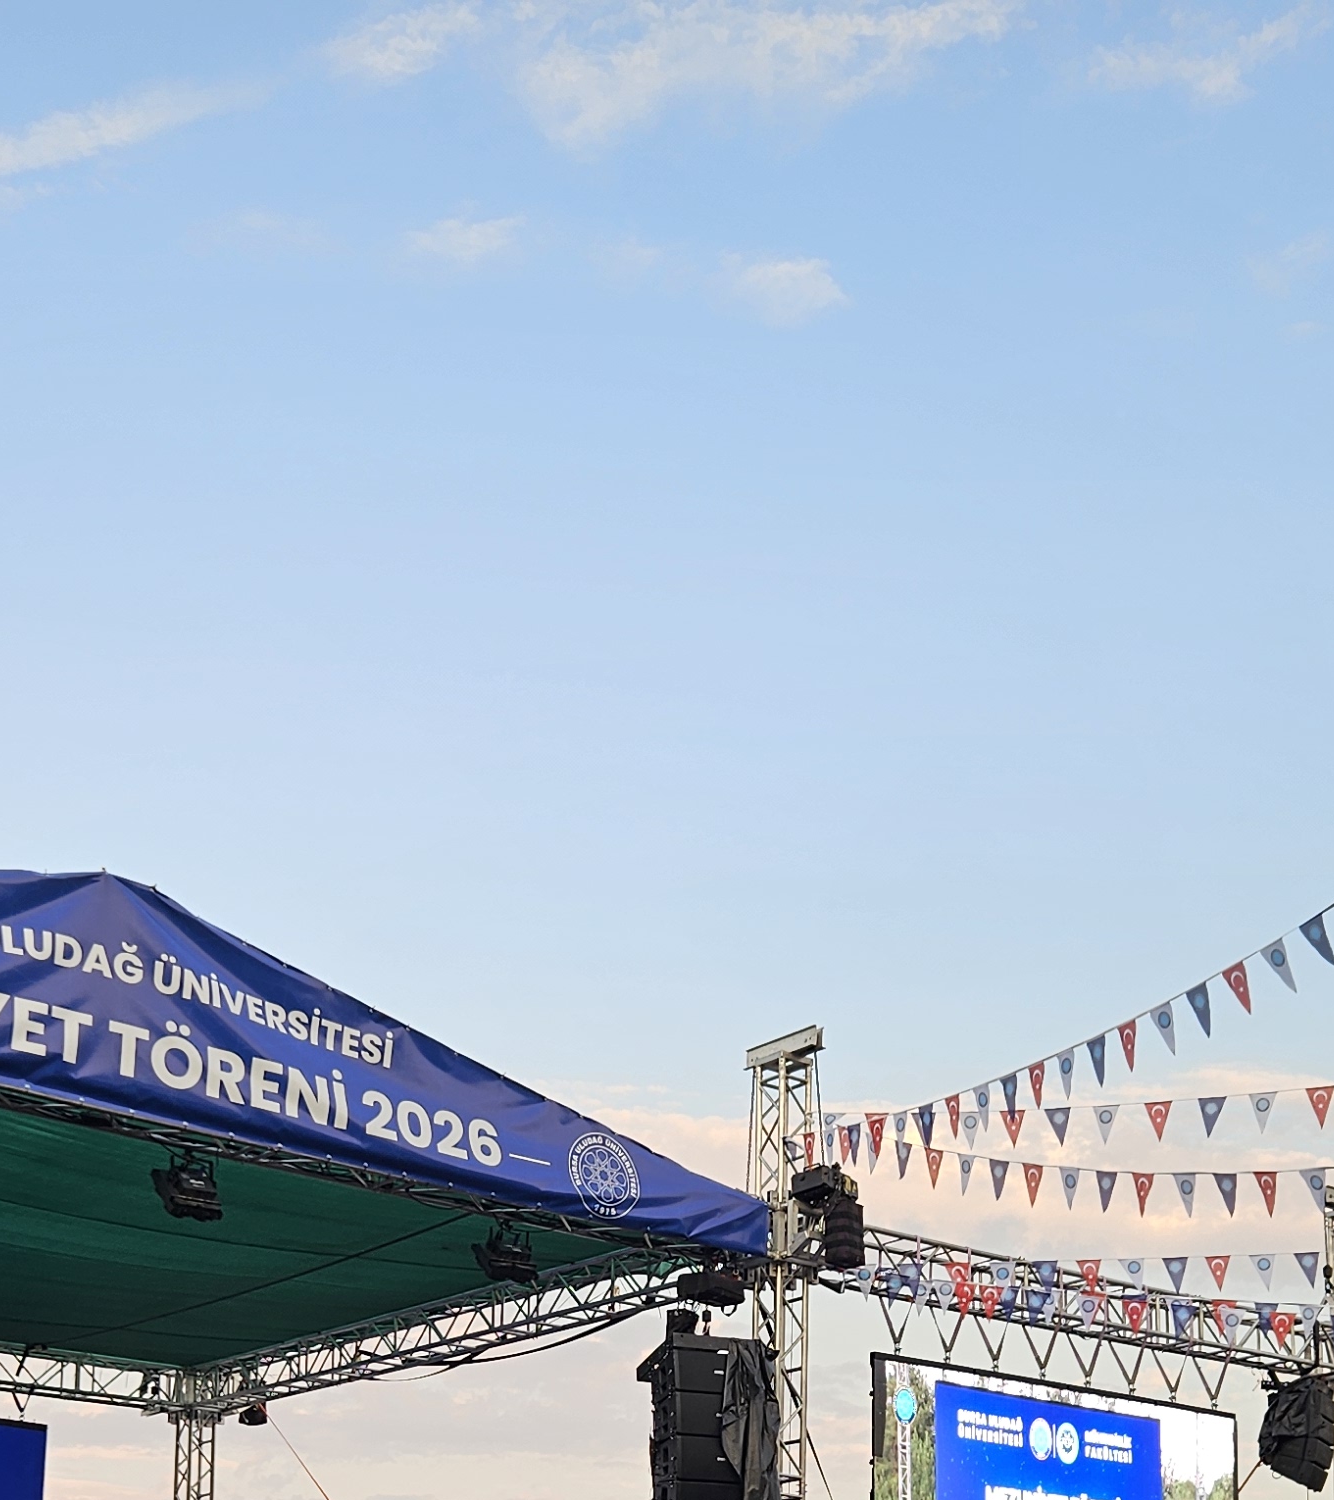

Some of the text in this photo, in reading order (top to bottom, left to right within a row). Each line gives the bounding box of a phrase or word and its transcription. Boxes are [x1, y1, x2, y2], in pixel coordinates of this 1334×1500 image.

[153, 953, 394, 1069] ÜNİVERSİTESİ
[108, 1019, 349, 1130] TÖRENİ
[361, 1090, 502, 1167] 2026
